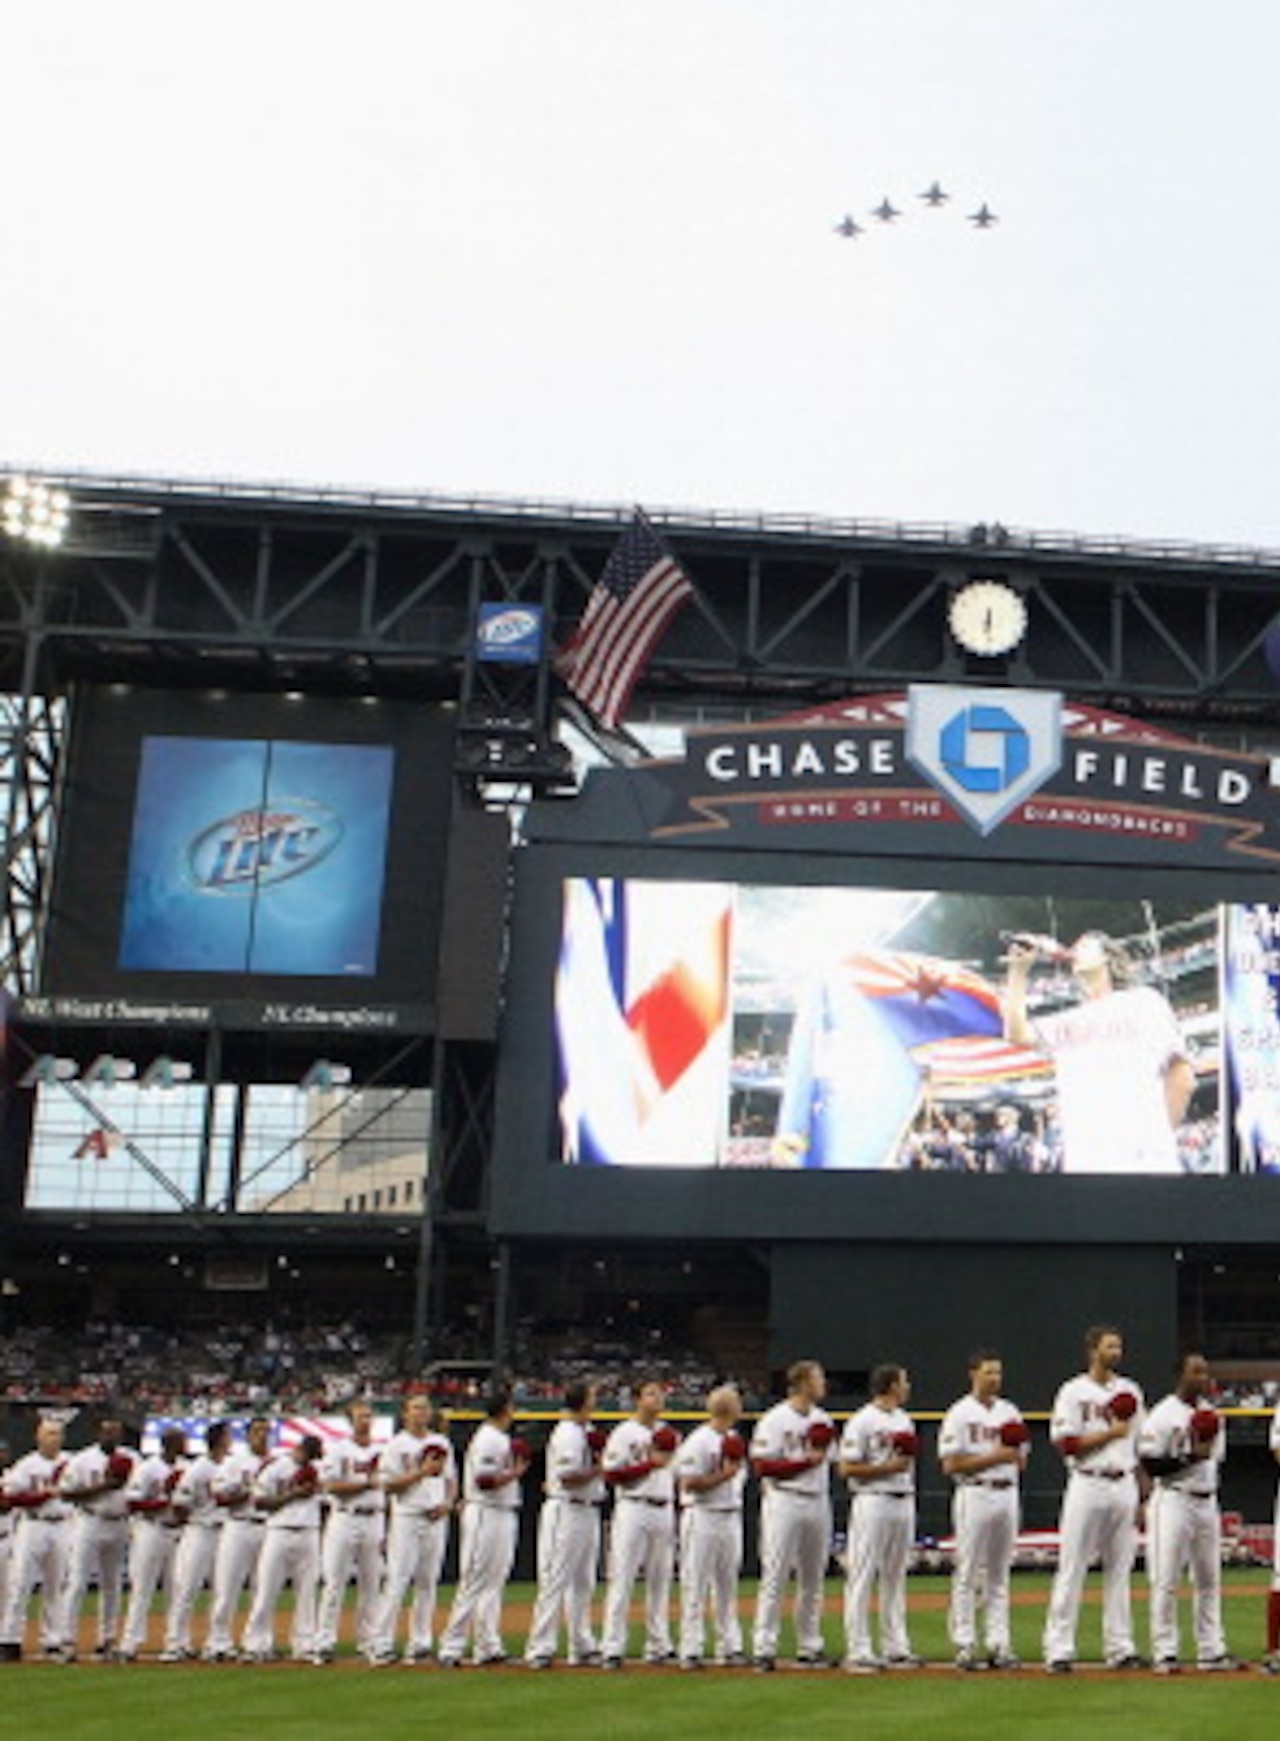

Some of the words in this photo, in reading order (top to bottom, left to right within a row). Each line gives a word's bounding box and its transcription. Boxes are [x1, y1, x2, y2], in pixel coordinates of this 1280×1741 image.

[705, 739, 896, 782] CHASE
[1074, 750, 1251, 804] FIELD
[853, 801, 883, 816] OF
[901, 800, 942, 816] THE
